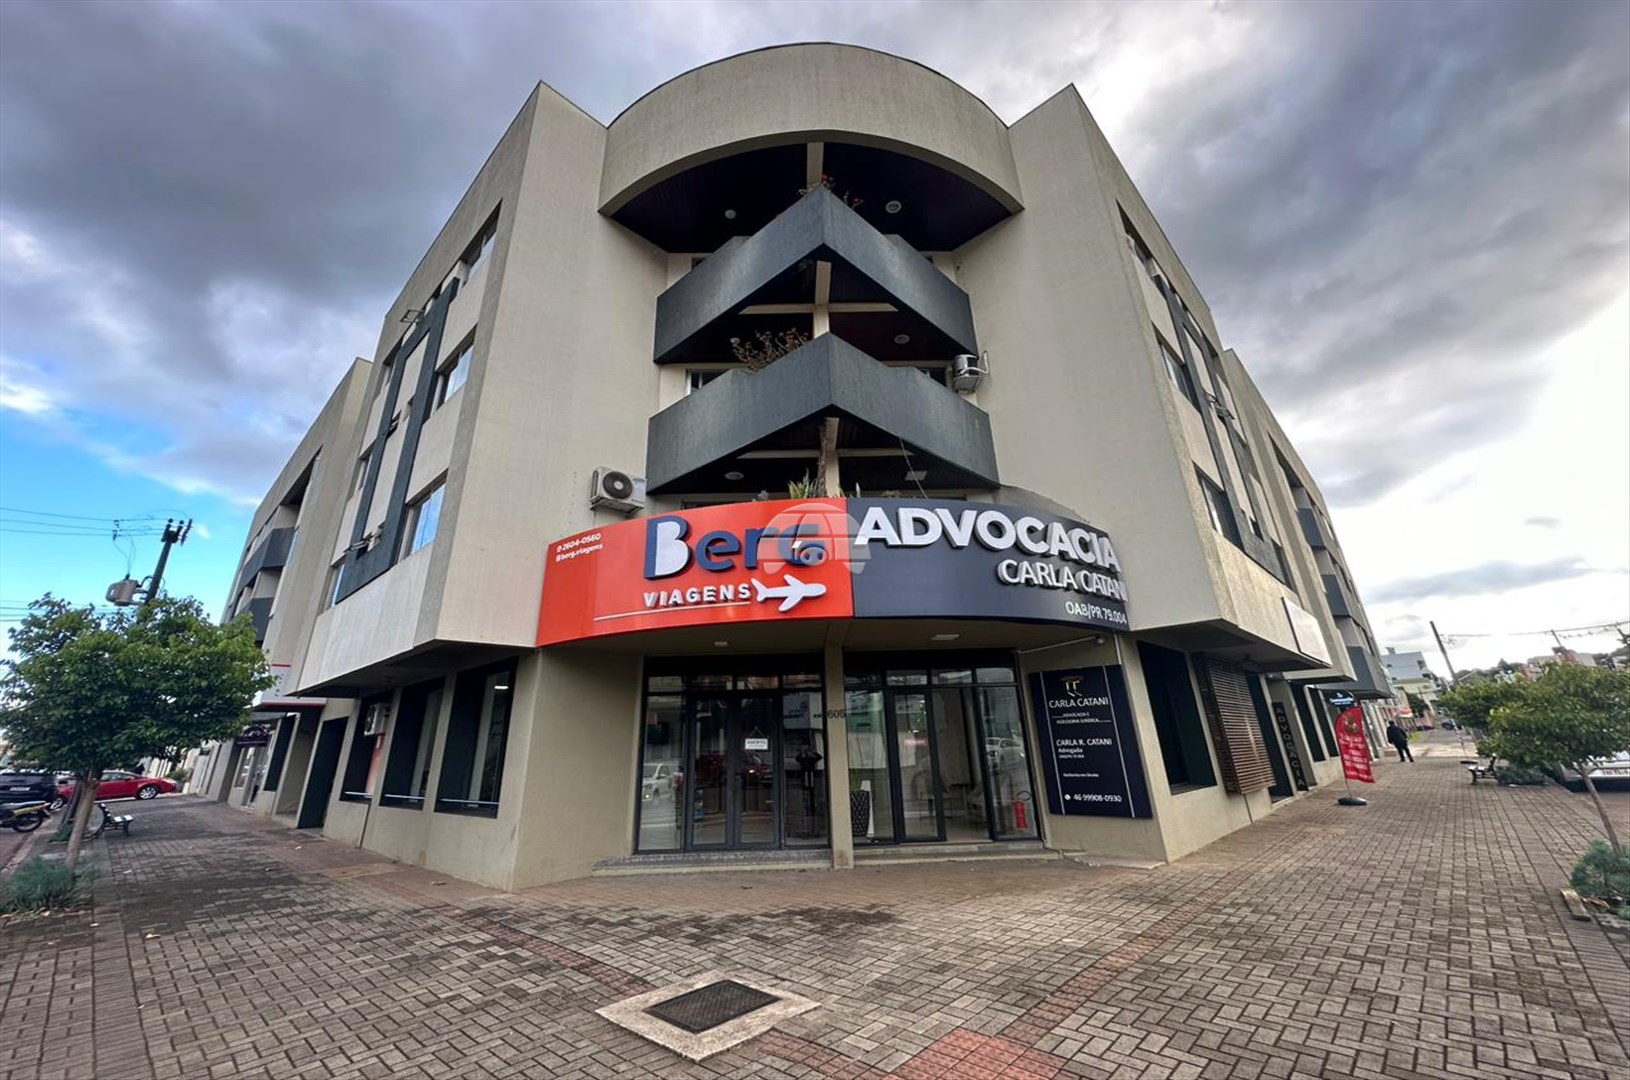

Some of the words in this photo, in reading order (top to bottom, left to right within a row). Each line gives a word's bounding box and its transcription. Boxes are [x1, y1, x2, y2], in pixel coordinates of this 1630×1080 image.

[853, 506, 1122, 573] ADVOCACIA
[998, 559, 1078, 590] CARLA
[643, 583, 752, 608] VIAGENS
[1065, 601, 1104, 620] OAB/PR
[1049, 699, 1077, 708] CARLA
[1077, 697, 1109, 706] CATANI
